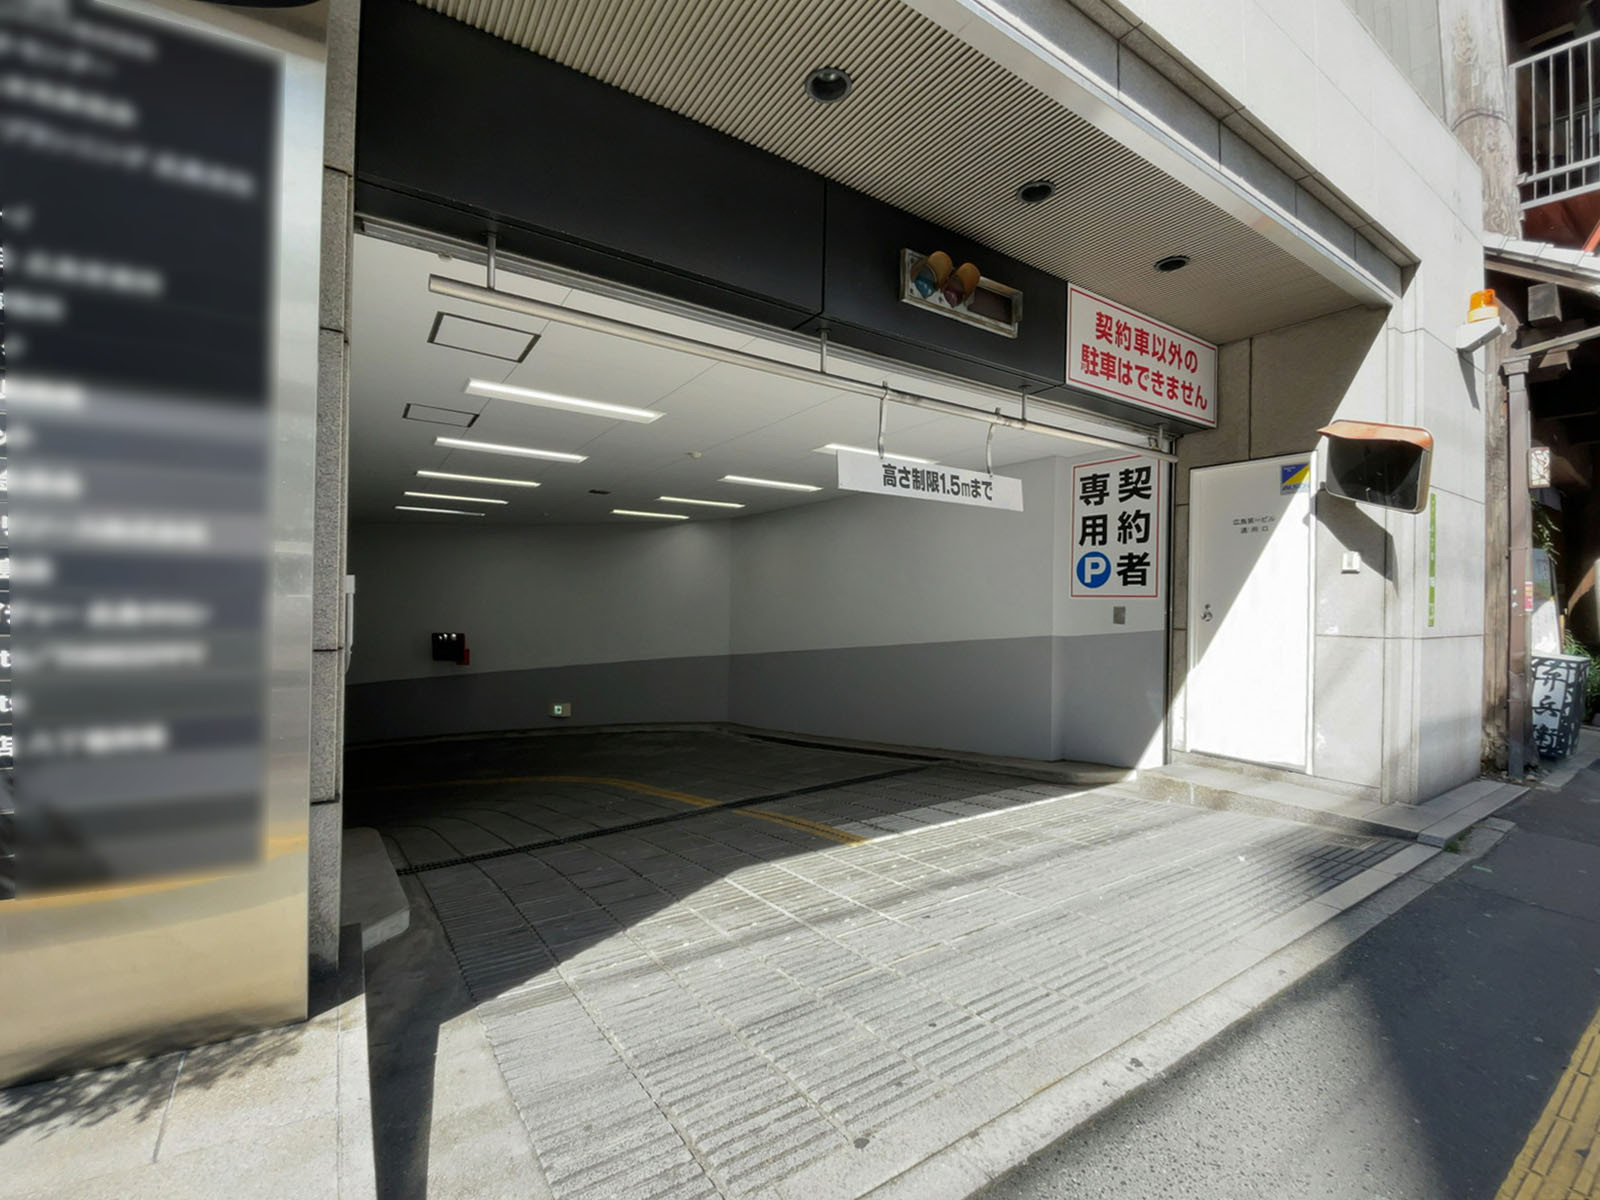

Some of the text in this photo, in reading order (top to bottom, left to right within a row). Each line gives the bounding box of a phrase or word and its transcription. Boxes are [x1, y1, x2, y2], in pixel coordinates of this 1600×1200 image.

[1080, 343, 1208, 411] 駐車はできません
[1095, 312, 1198, 374] 契約車以外の
[1079, 473, 1110, 546] 専用
[1116, 466, 1152, 587] 契約者
